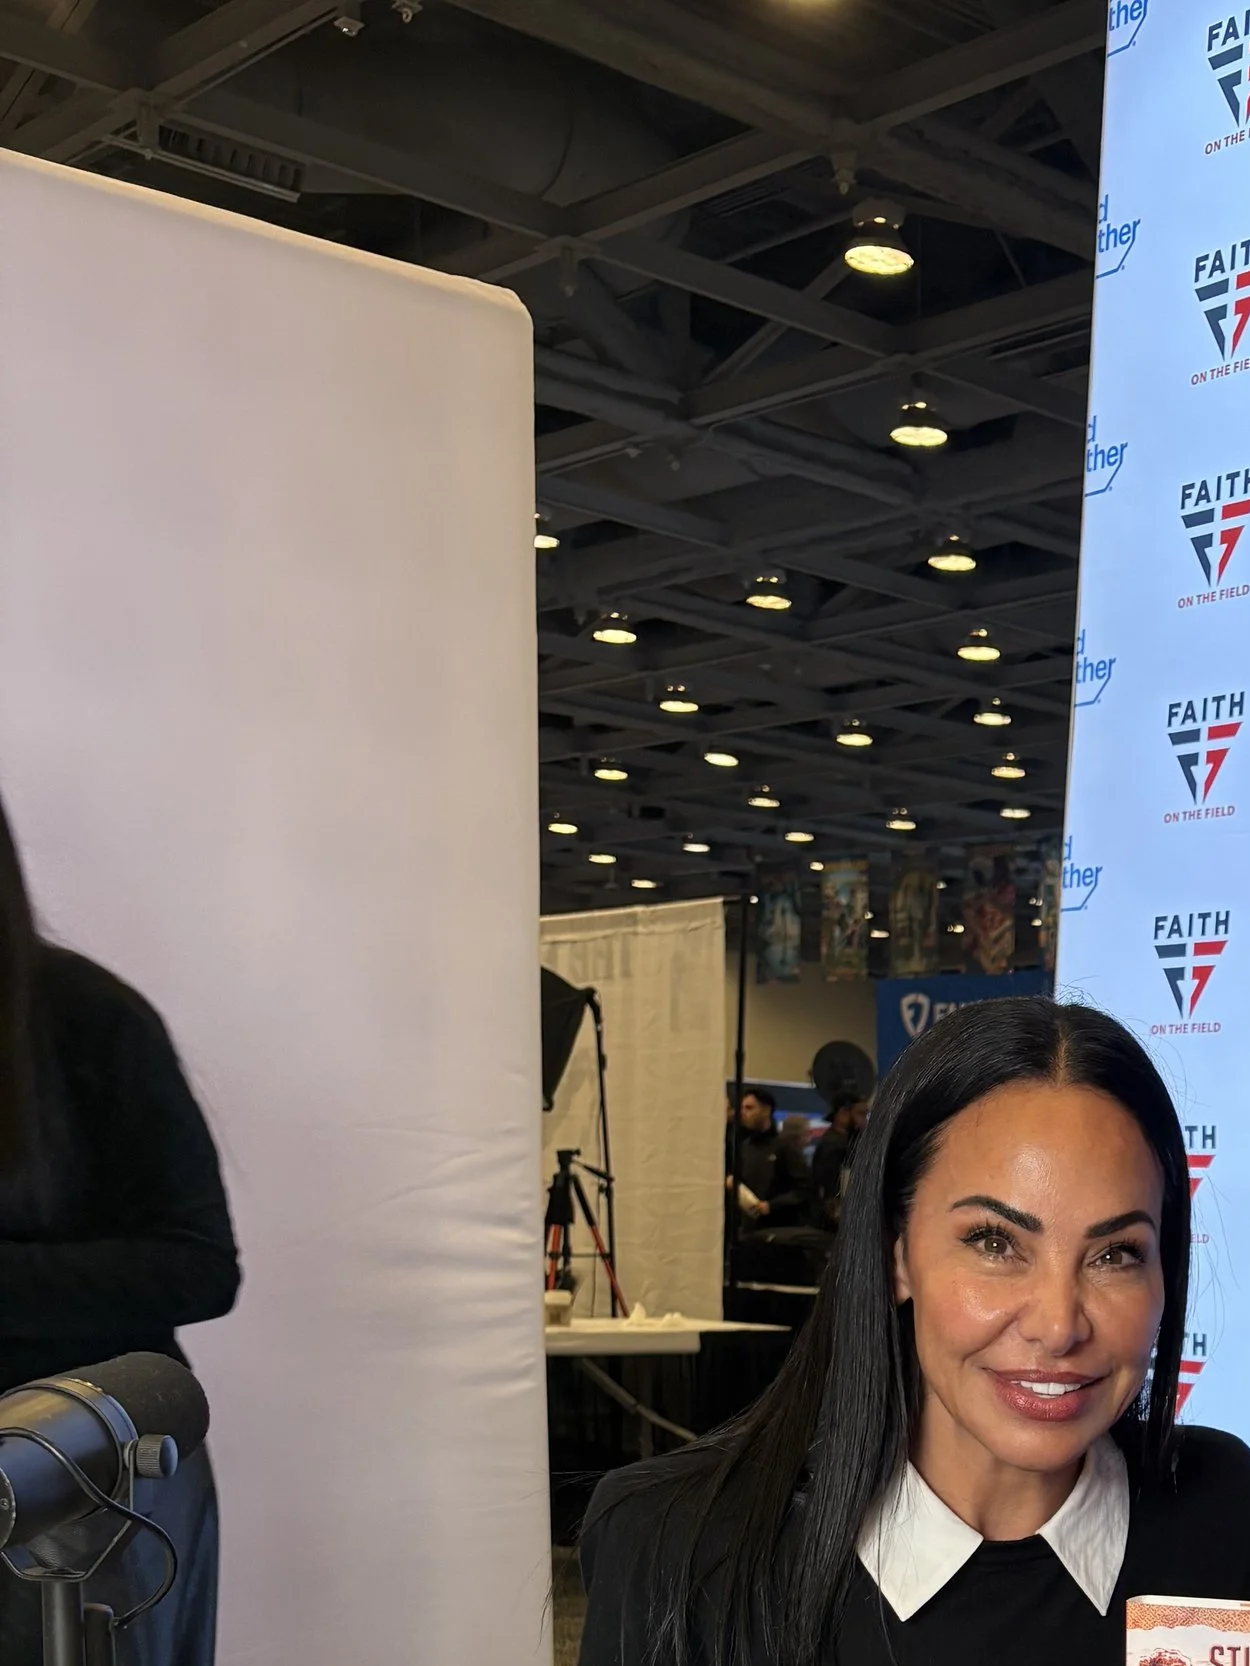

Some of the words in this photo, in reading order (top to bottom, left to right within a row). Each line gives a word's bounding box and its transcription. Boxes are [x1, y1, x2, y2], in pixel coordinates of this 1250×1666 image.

[1204, 139, 1221, 155] ON
[1223, 130, 1245, 149] THE
[1191, 371, 1207, 386] ON
[1209, 364, 1231, 381] THE
[1177, 595, 1194, 609] ON
[1196, 590, 1217, 606] THE
[1219, 584, 1250, 600] FIELD
[1167, 691, 1245, 728] FAITH
[1163, 812, 1180, 824] ON
[1182, 808, 1202, 822] THE
[1204, 805, 1236, 819] FIELD
[1153, 910, 1230, 940] FAITH
[1151, 1024, 1166, 1036] ON
[1168, 1023, 1189, 1035] THE
[1190, 1022, 1221, 1034] FIELD
[1185, 1125, 1217, 1149] TH
